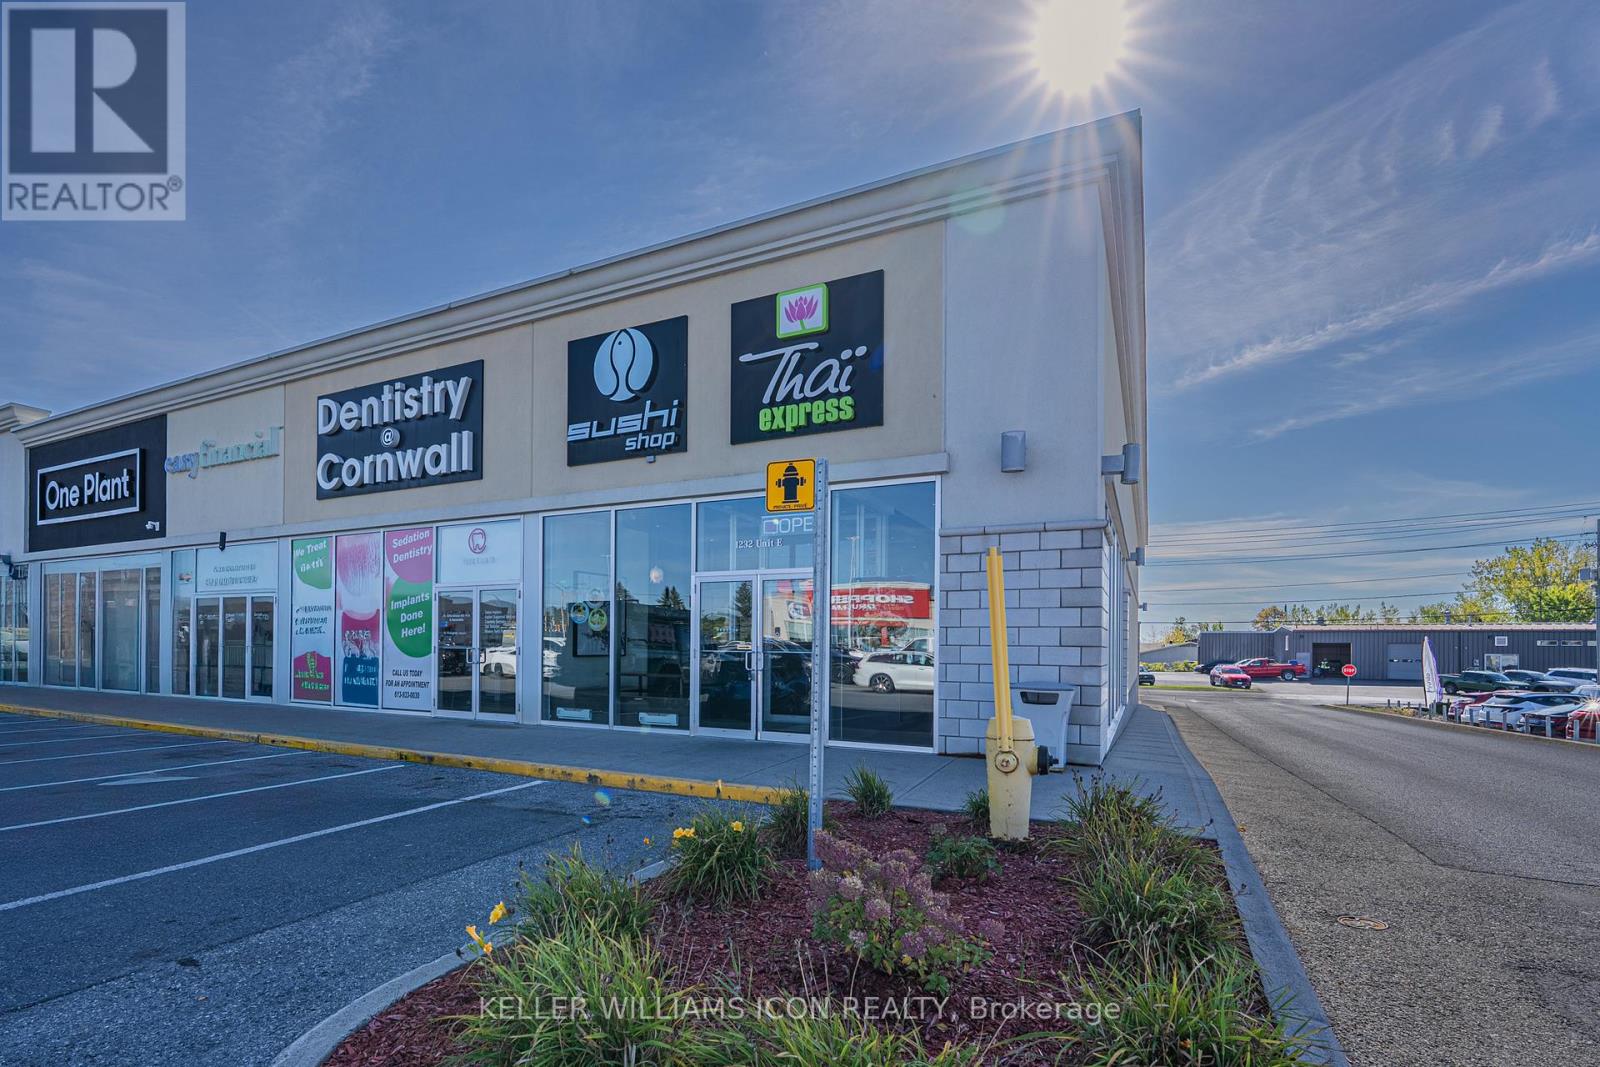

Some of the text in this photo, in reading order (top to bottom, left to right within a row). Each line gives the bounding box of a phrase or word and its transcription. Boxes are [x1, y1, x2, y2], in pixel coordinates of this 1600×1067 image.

[739, 342, 867, 404] Thaï
[318, 376, 472, 435] Dentistry
[759, 396, 855, 432] express
[567, 400, 678, 441] sushi
[381, 428, 398, 448] @
[625, 432, 675, 451] shop
[317, 430, 473, 490] Cornwall
[45, 468, 130, 510] One Plant
[779, 516, 814, 533] OPE
[392, 530, 430, 548] Sedation
[756, 538, 774, 548] Unit
[393, 545, 433, 563] Dentistry
[390, 592, 430, 610] Implants
[400, 610, 424, 623] Done
[401, 622, 426, 638] Here!
[392, 669, 402, 677] CALL
[410, 669, 423, 677] TODAY
[400, 680, 430, 688] APPOINTMENT
